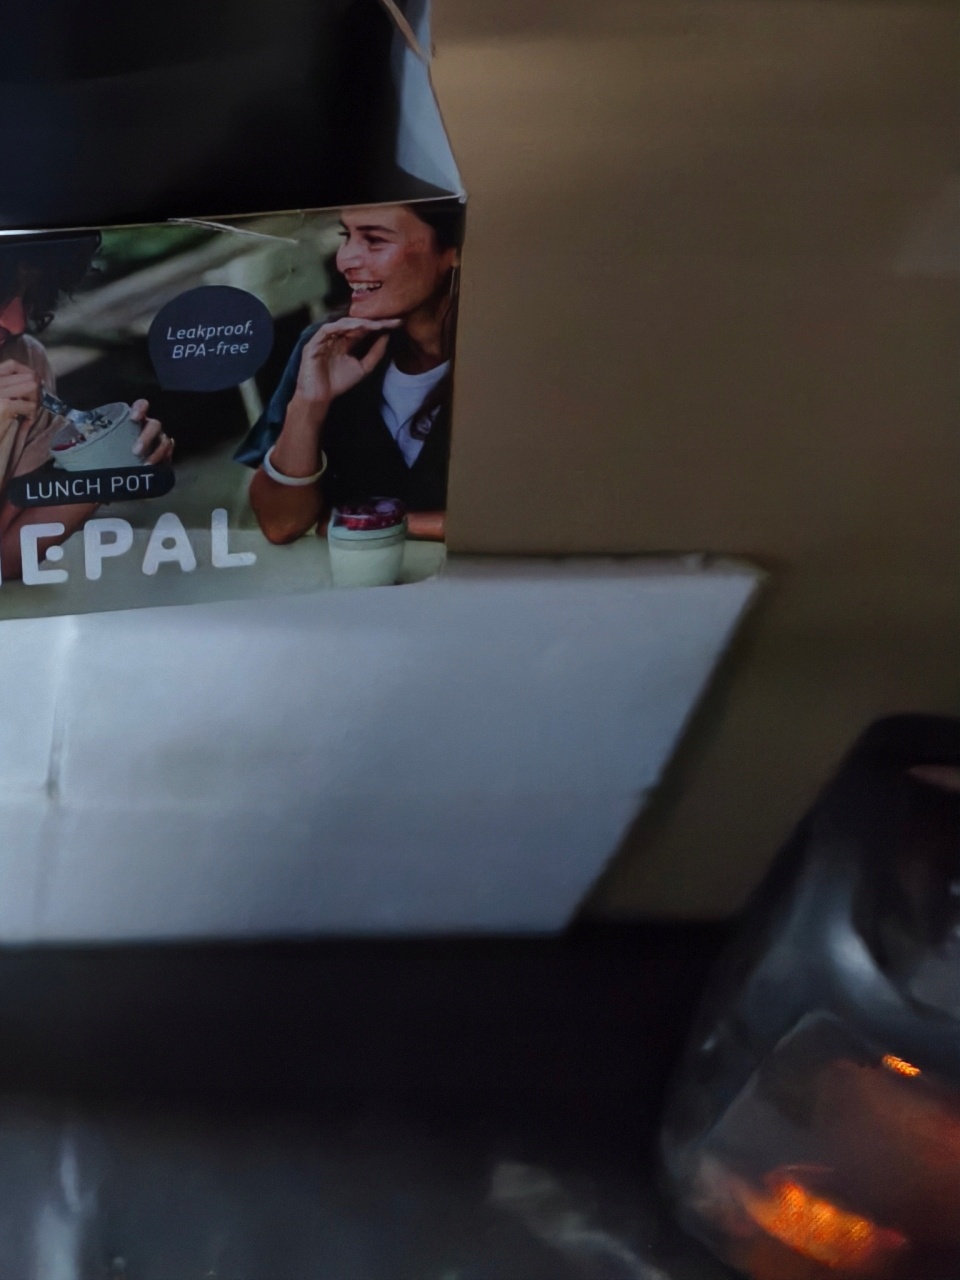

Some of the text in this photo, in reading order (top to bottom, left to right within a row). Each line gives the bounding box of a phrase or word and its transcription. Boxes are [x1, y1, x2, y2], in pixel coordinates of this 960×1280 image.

[172, 341, 249, 359] BPA-free
[25, 473, 155, 500] LUNCH POT
